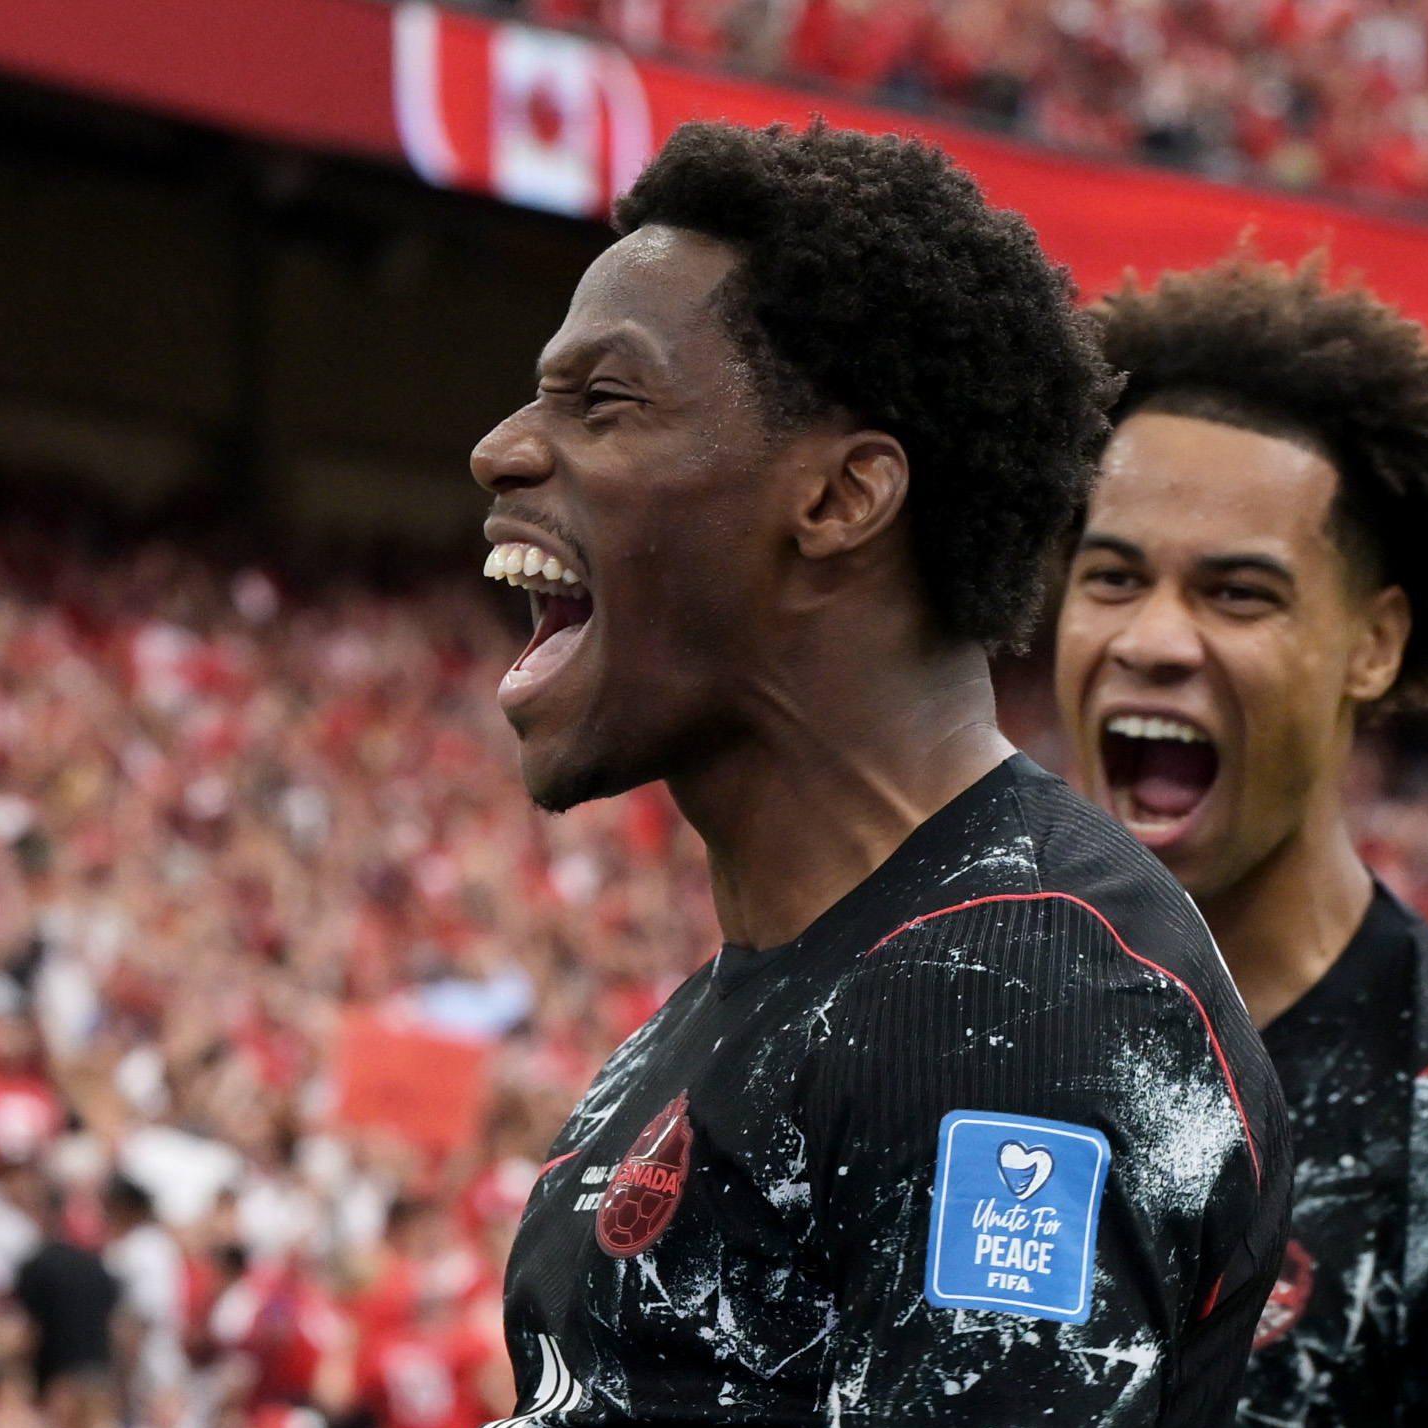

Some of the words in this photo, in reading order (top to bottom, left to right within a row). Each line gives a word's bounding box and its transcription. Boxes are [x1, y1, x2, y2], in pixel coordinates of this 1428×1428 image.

[615, 1162, 679, 1195] CANADA
[972, 1198, 1030, 1233] Unite
[1031, 1207, 1063, 1238] For
[974, 1234, 1054, 1274] PEACE
[987, 1272, 1031, 1292] FIFA
